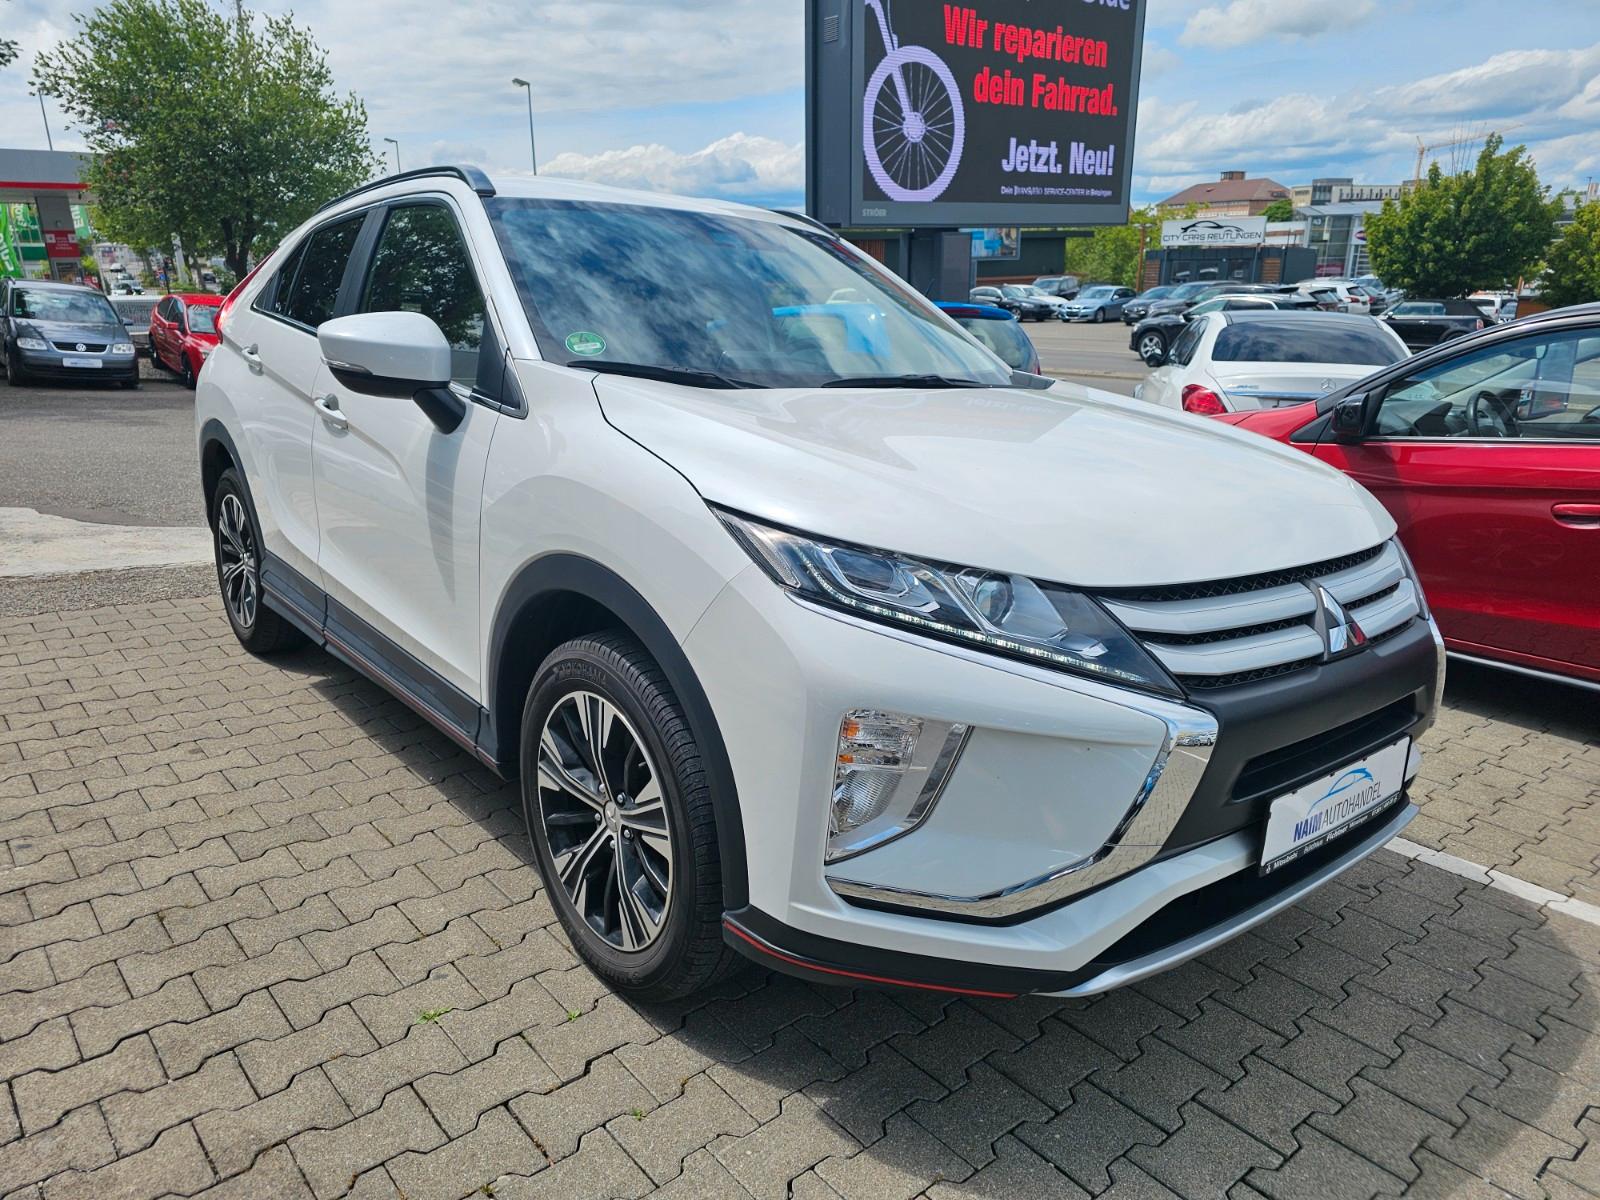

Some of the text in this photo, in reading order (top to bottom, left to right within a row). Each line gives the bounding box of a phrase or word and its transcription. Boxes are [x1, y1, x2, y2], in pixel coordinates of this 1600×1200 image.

[943, 4, 1108, 68] Wir reparieren
[973, 66, 1118, 117] dein Fahrrad.
[1001, 137, 1115, 176] Jetzt. Neu!
[1163, 234, 1180, 242] CITY
[1182, 233, 1206, 242] CARS
[1207, 231, 1262, 240] REUTLINGEN
